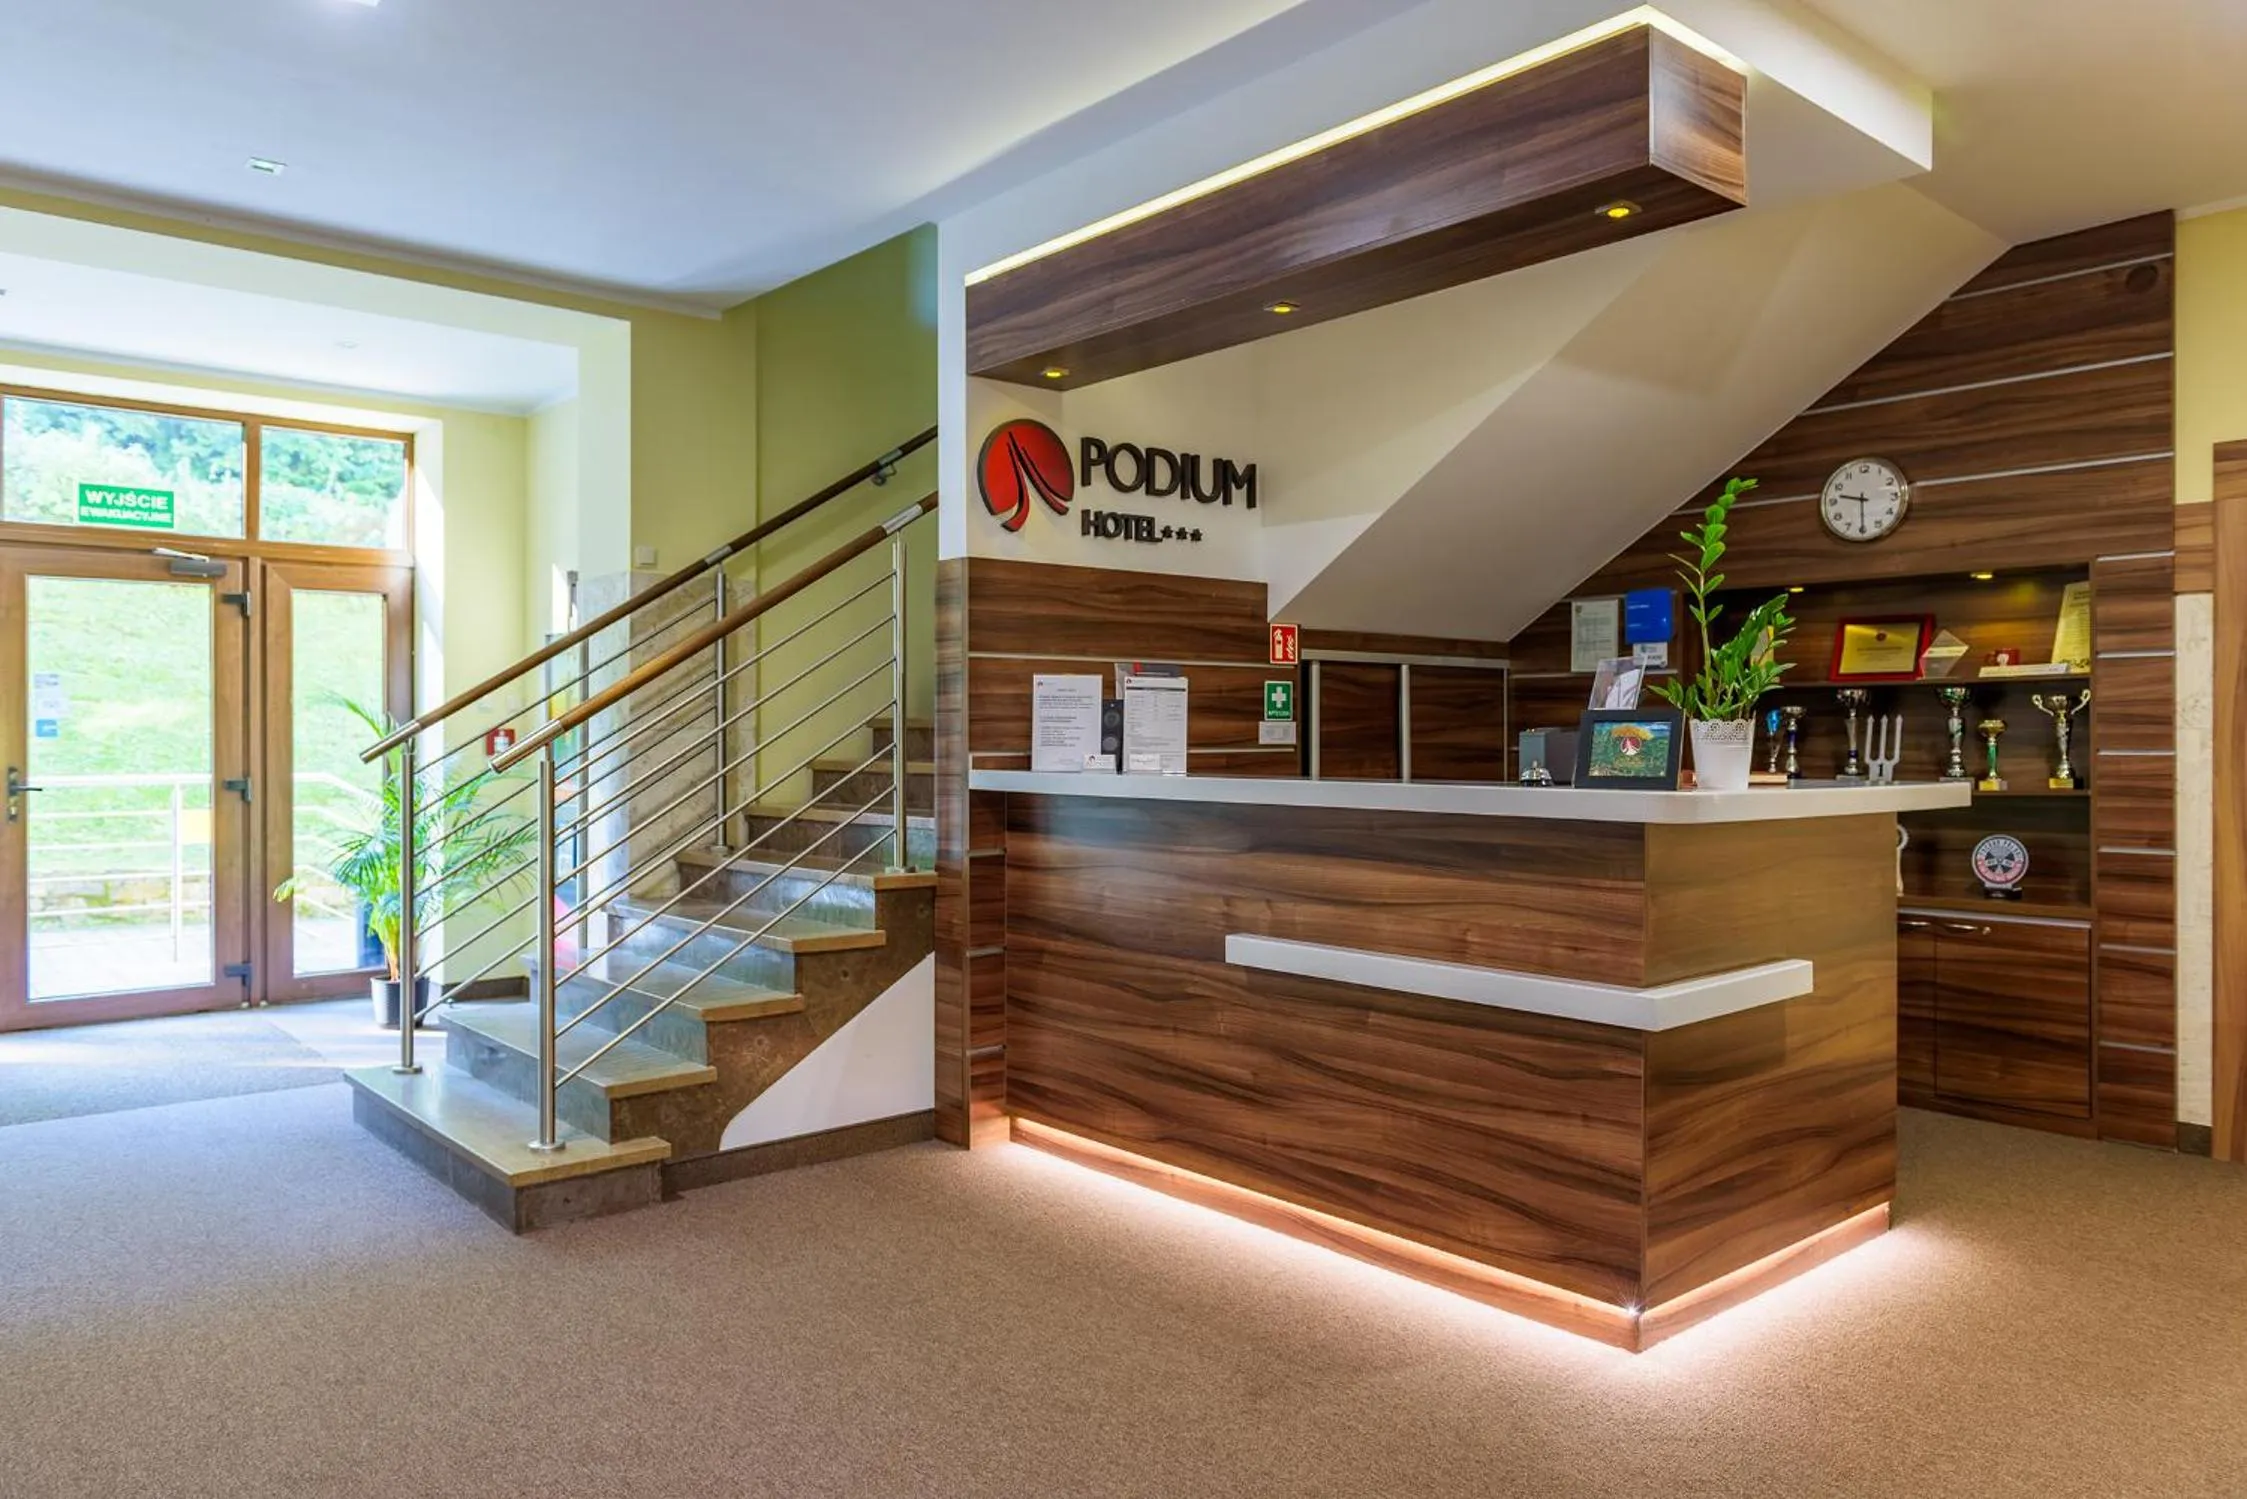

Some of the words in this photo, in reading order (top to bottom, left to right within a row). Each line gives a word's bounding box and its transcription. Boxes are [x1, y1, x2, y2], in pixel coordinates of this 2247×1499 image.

[1081, 436, 1257, 509] PODIUM
[1859, 464, 1870, 474] 12
[1845, 472, 1852, 480] 11
[1886, 477, 1894, 486] 2
[1834, 483, 1843, 491] 10
[84, 489, 169, 510] WYJŚCIE
[1890, 492, 1898, 501] 3
[1829, 497, 1838, 506] 9
[1886, 507, 1893, 516] 4
[1845, 522, 1852, 531] 7
[1874, 520, 1882, 528] 5
[1878, 763, 1884, 777] 1
